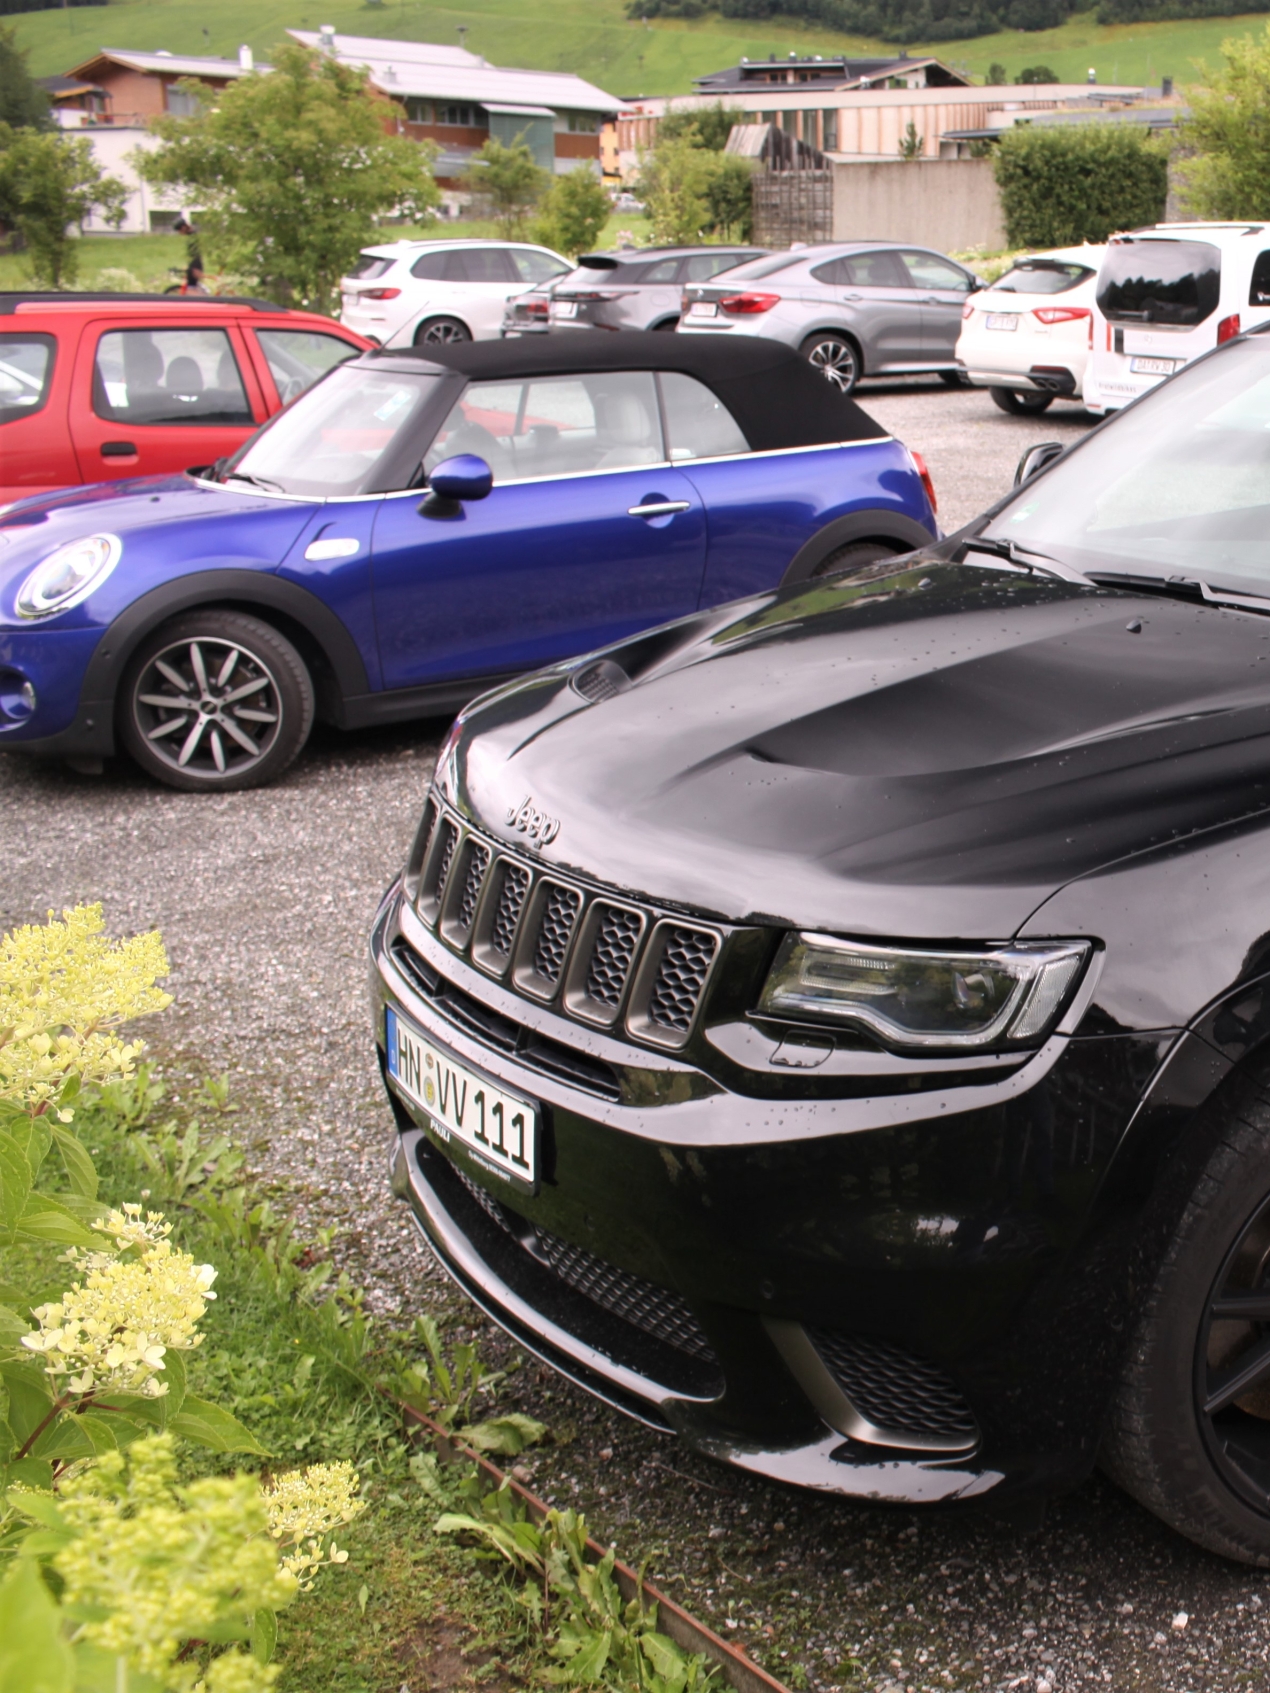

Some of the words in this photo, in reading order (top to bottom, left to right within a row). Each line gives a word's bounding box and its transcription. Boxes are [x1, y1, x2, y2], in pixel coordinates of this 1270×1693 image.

[504, 794, 561, 850] Jeep
[397, 1027, 421, 1096] HN
[435, 1059, 467, 1128] VV
[474, 1088, 531, 1171] 111
[430, 1119, 450, 1143] PAULI
